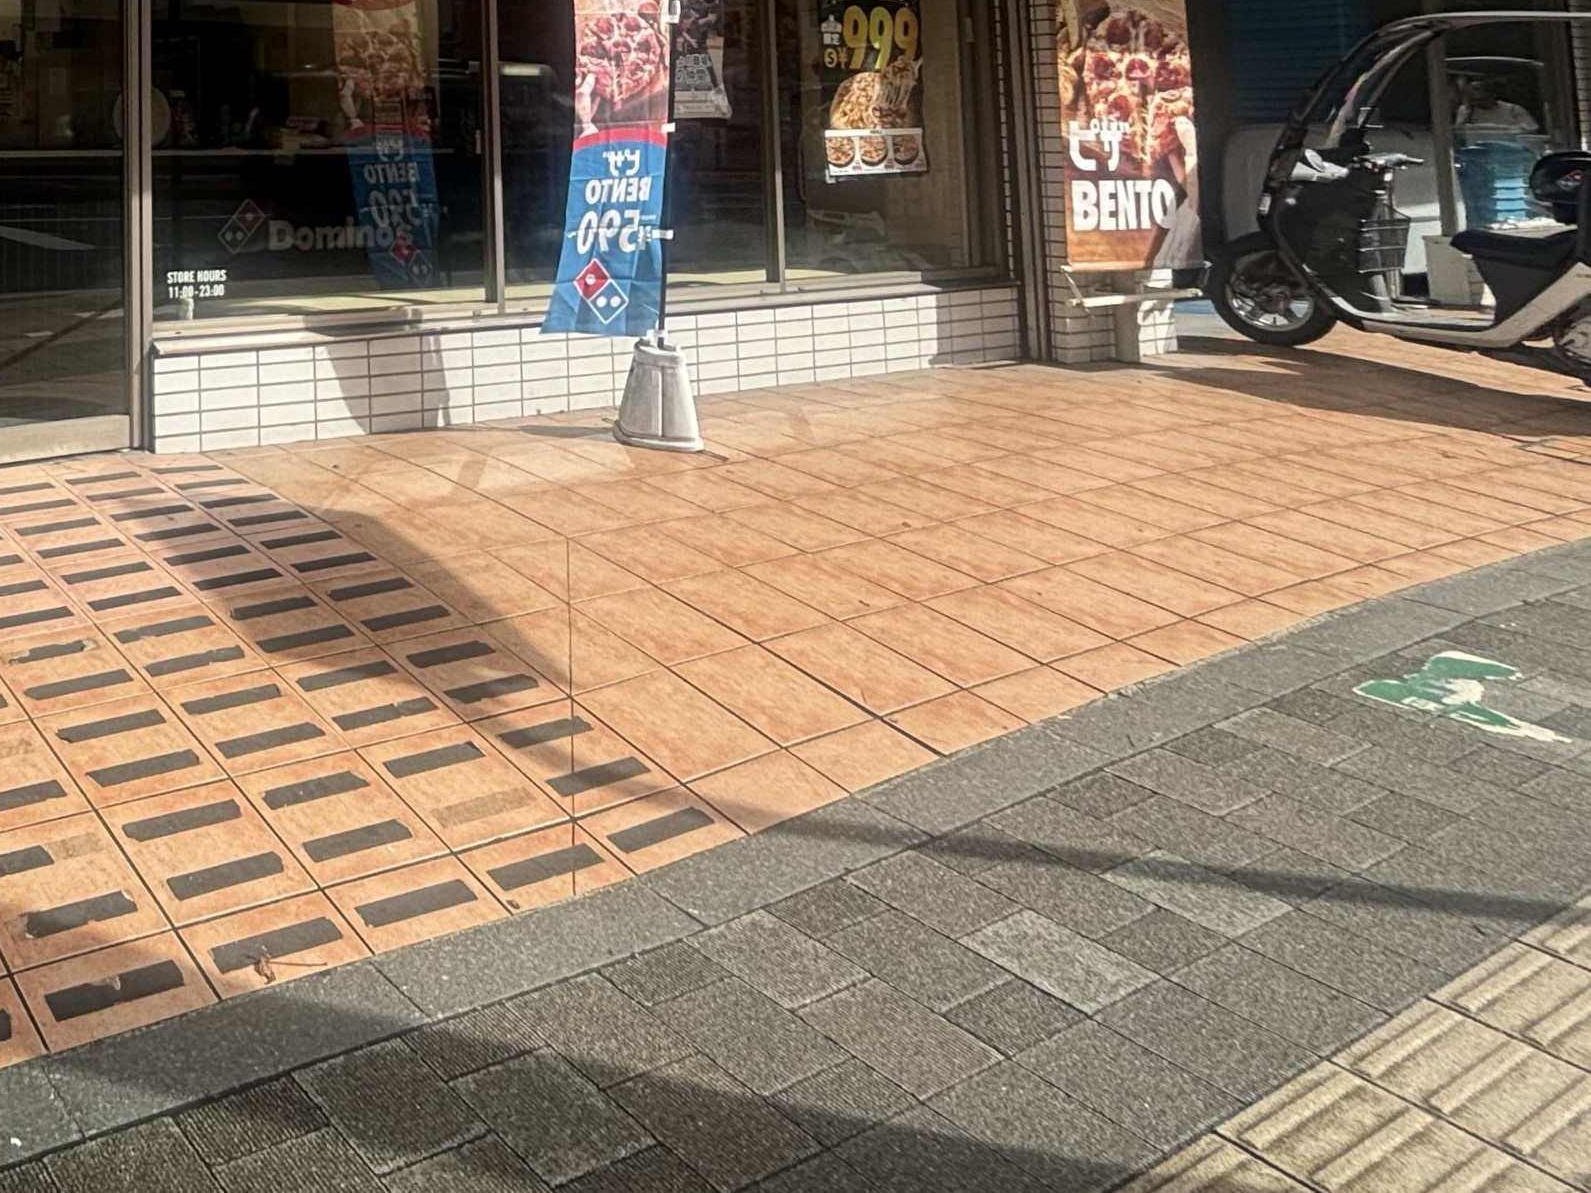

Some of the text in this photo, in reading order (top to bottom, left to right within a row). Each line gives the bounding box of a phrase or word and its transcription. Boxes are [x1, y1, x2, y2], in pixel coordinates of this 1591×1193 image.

[1068, 117, 1129, 172] ピザ
[1071, 179, 1176, 231] BENTO
[166, 269, 227, 284] STORE HOURS
[168, 283, 225, 299] 11:00-23:00
